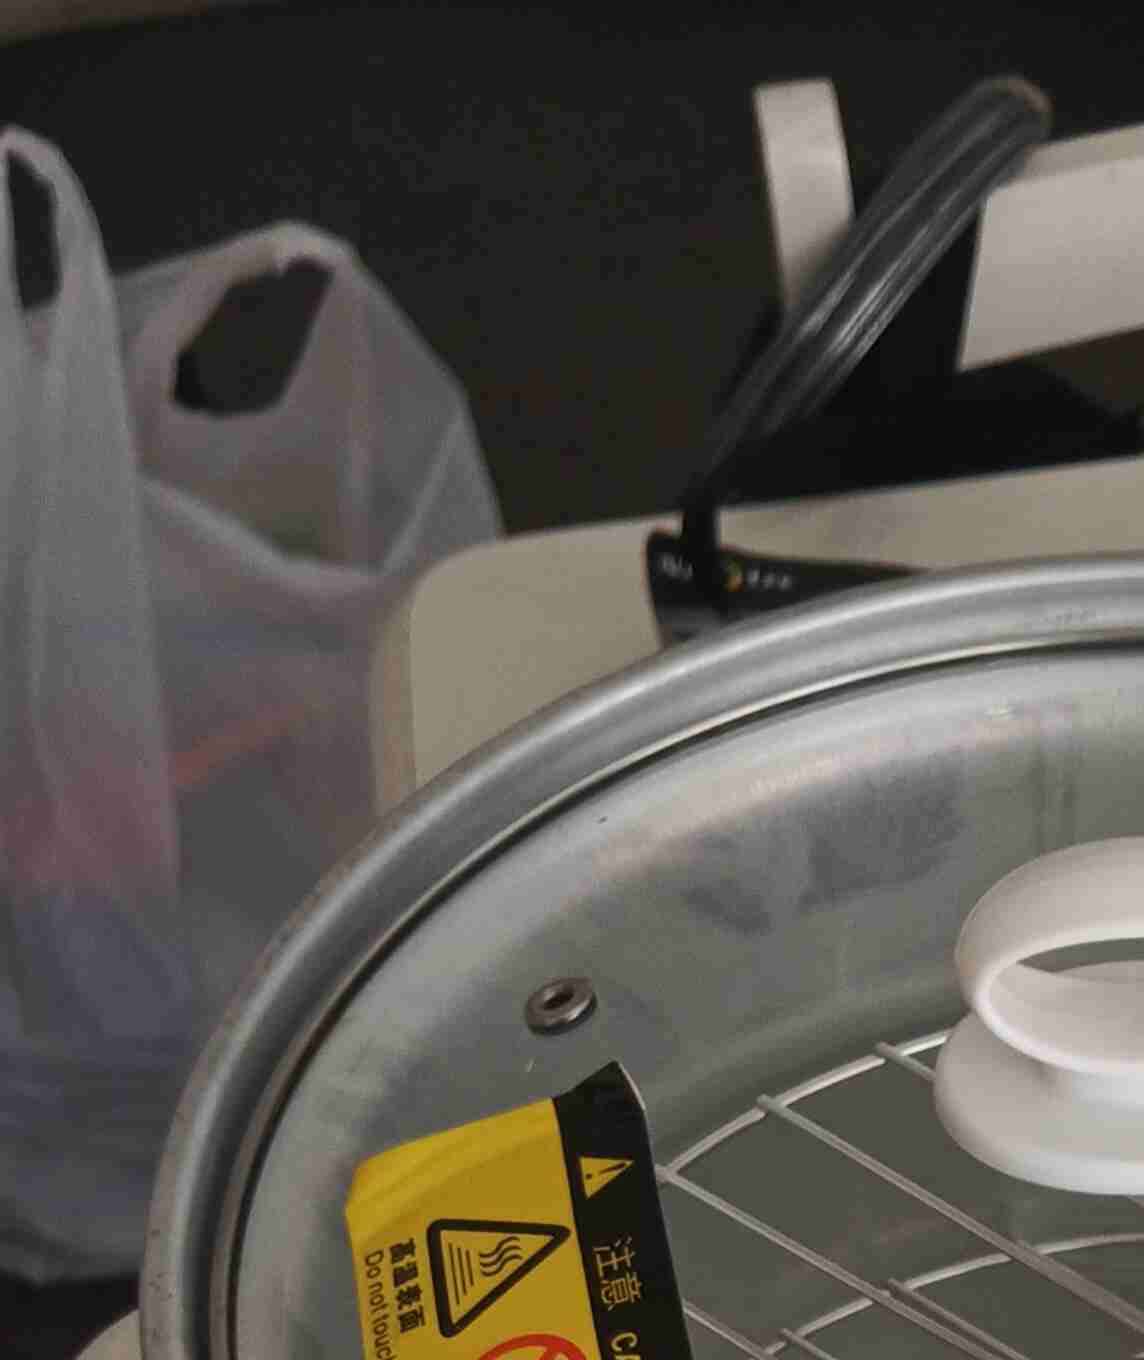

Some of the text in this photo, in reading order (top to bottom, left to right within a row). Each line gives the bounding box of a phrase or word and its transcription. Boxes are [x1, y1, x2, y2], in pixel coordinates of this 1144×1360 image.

[365, 1250, 384, 1279] Do
[593, 1236, 642, 1311] 注意
[368, 1281, 388, 1314] not
